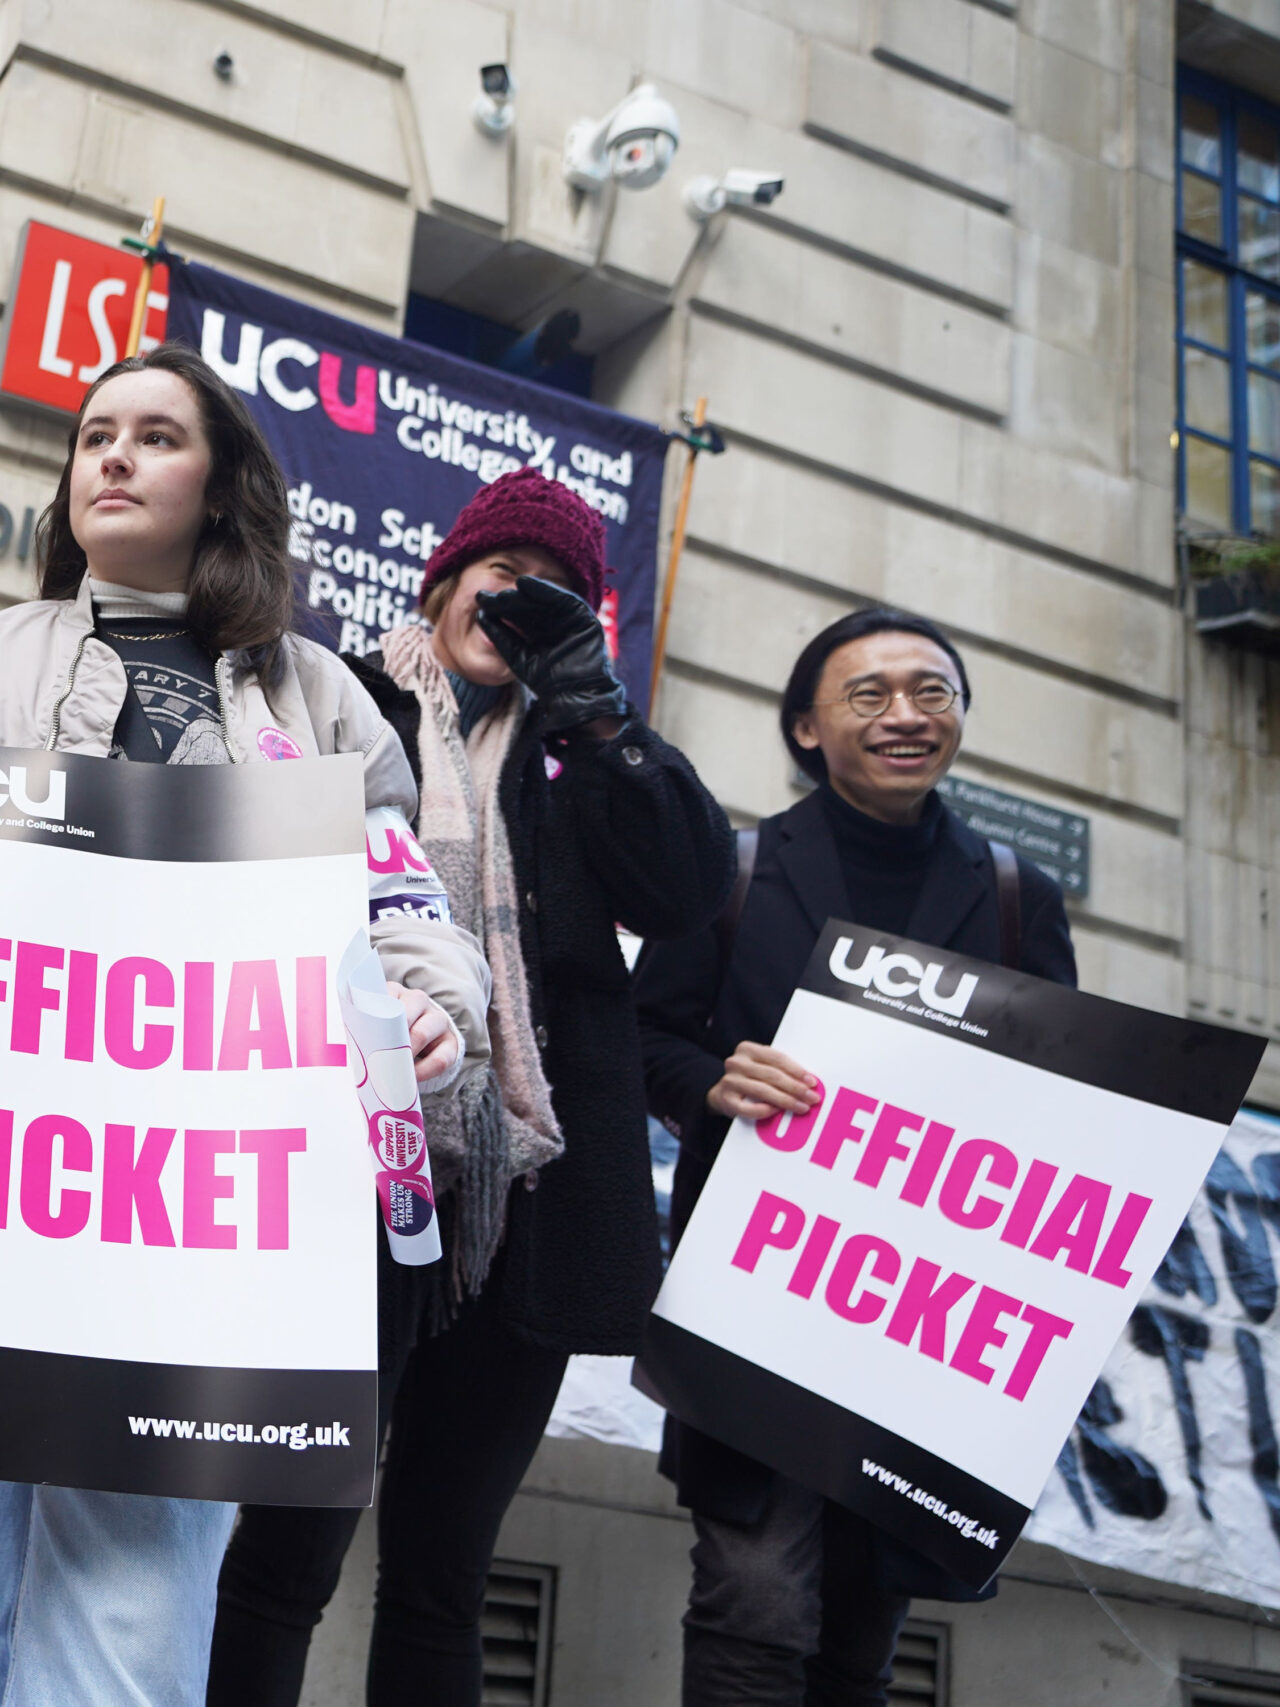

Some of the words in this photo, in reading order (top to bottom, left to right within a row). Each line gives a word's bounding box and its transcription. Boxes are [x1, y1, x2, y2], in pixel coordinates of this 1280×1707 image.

[379, 368, 556, 465] University
[570, 444, 632, 487] and
[397, 416, 524, 484] College
[127, 669, 188, 689] ARY
[5, 818, 24, 828] and
[26, 819, 64, 834] College
[66, 825, 95, 838] Union
[829, 936, 979, 1018] UCU
[863, 989, 908, 1011] University
[906, 1004, 924, 1016] and
[924, 1009, 959, 1028] College
[961, 1020, 988, 1037] Union
[385, 1121, 394, 1157] SUPPORT
[395, 1121, 407, 1167] UNIVERSITY
[408, 1131, 417, 1155] STAFF
[389, 1180, 398, 1209] UNION
[396, 1184, 405, 1196] US
[754, 1074, 1154, 1289] OFFICIAL
[396, 1197, 405, 1228] MAKES
[405, 1189, 413, 1224] STRONG
[730, 1190, 1075, 1402] PICKET
[128, 1416, 350, 1450] www.ucu.org.uk
[862, 1458, 1000, 1550] www.ucu.org.uk
